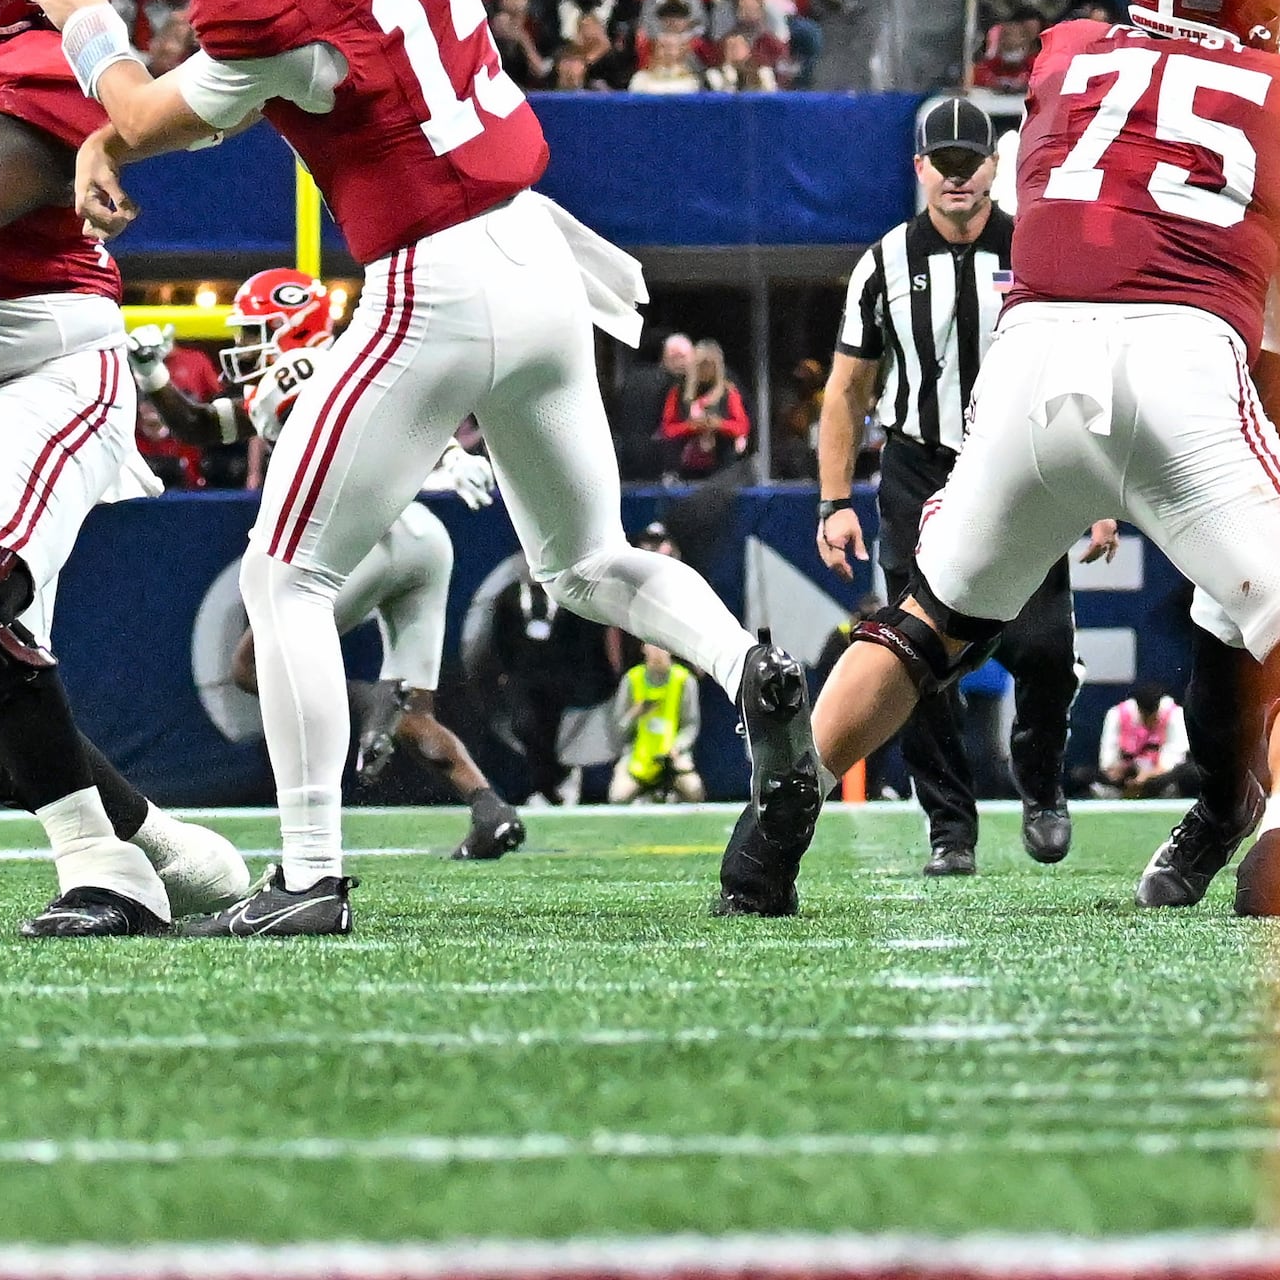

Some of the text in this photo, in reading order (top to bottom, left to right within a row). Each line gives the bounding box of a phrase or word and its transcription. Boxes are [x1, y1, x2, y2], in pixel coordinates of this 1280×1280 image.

[1042, 46, 1273, 229] 75
[912, 273, 927, 291] S
[274, 357, 314, 394] 20
[878, 627, 919, 660] DONJOY
